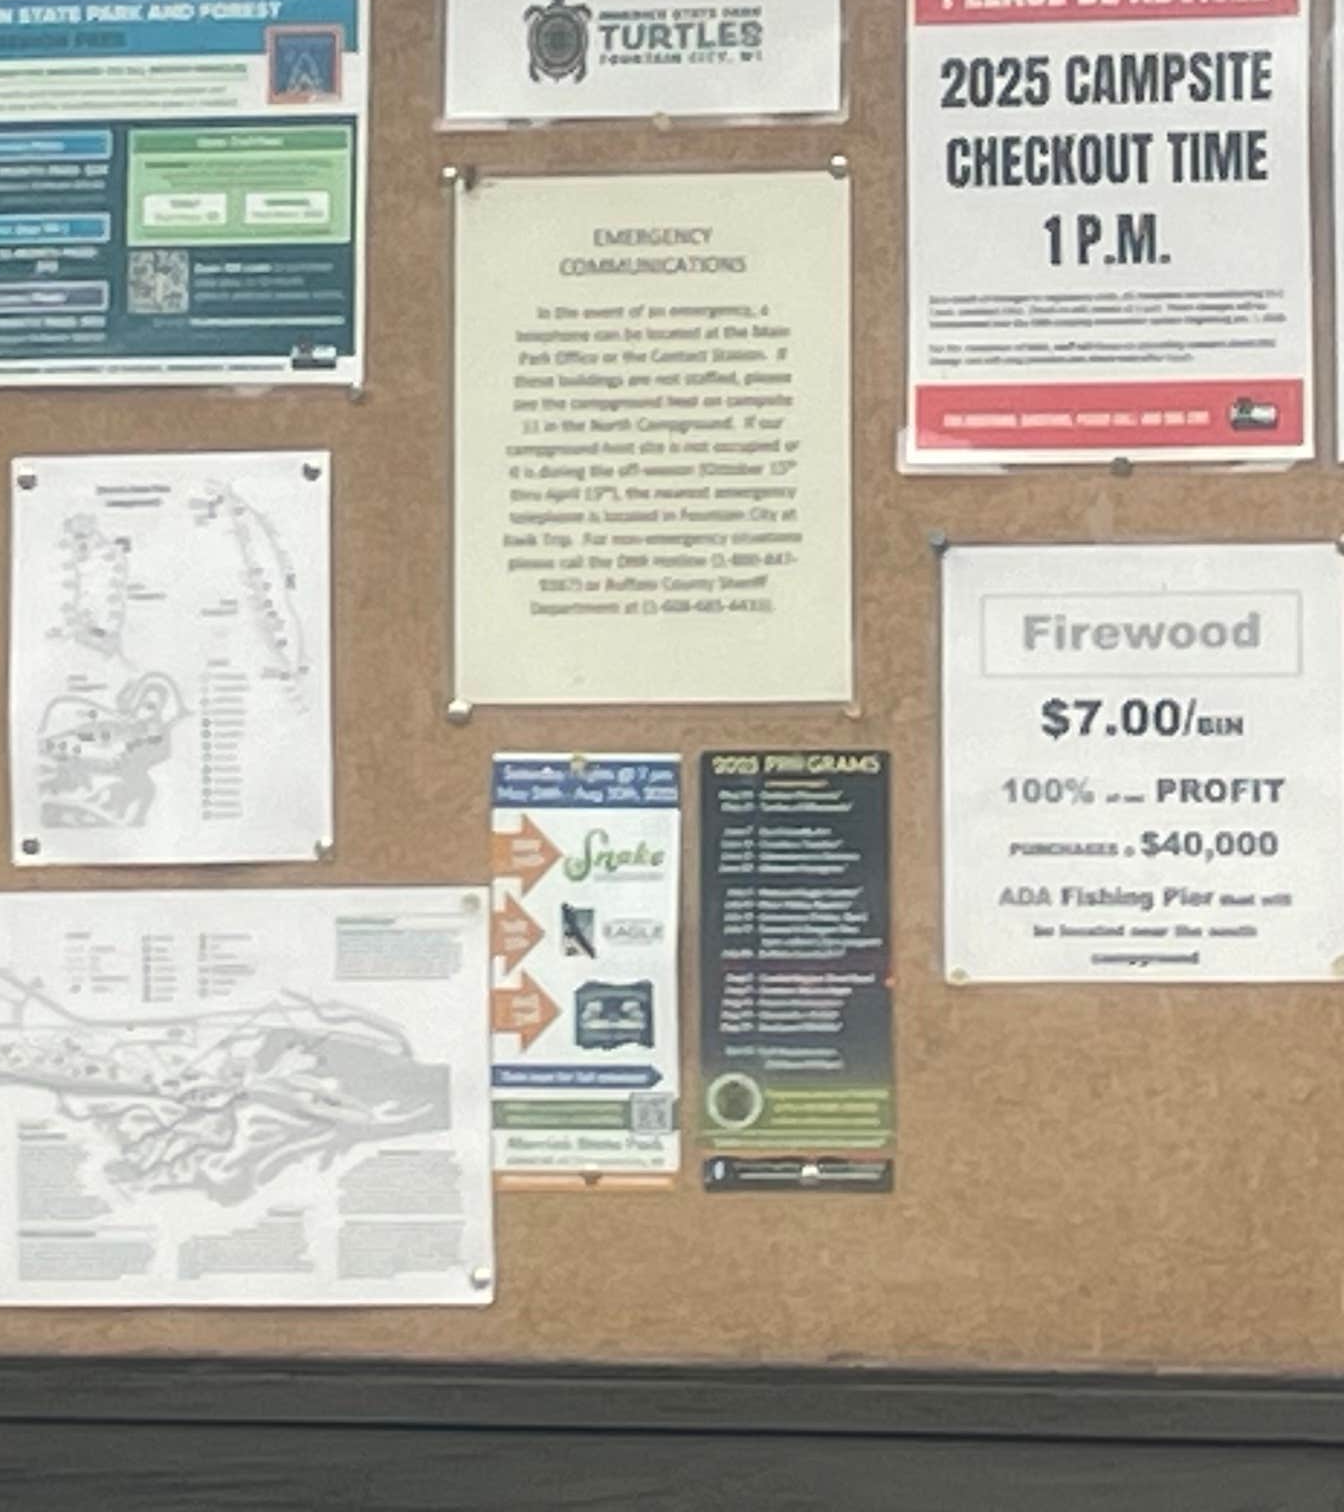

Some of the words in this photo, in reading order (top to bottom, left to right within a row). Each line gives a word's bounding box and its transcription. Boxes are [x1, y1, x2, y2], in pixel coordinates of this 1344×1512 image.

[597, 21, 763, 51] TURTLES
[940, 55, 1050, 109] 2025
[1065, 50, 1273, 105] CAMPSITE
[945, 132, 1153, 189] CHECKOUT
[1166, 129, 1269, 184] TIME
[1043, 214, 1063, 265] 1
[1077, 213, 1172, 265] P.M.
[1021, 612, 1263, 652] Firewood
[1040, 697, 1244, 739] $7.00/BIN
[1002, 776, 1096, 805] 100%
[1156, 777, 1286, 804] PROFIT
[1140, 830, 1279, 863] $40,000
